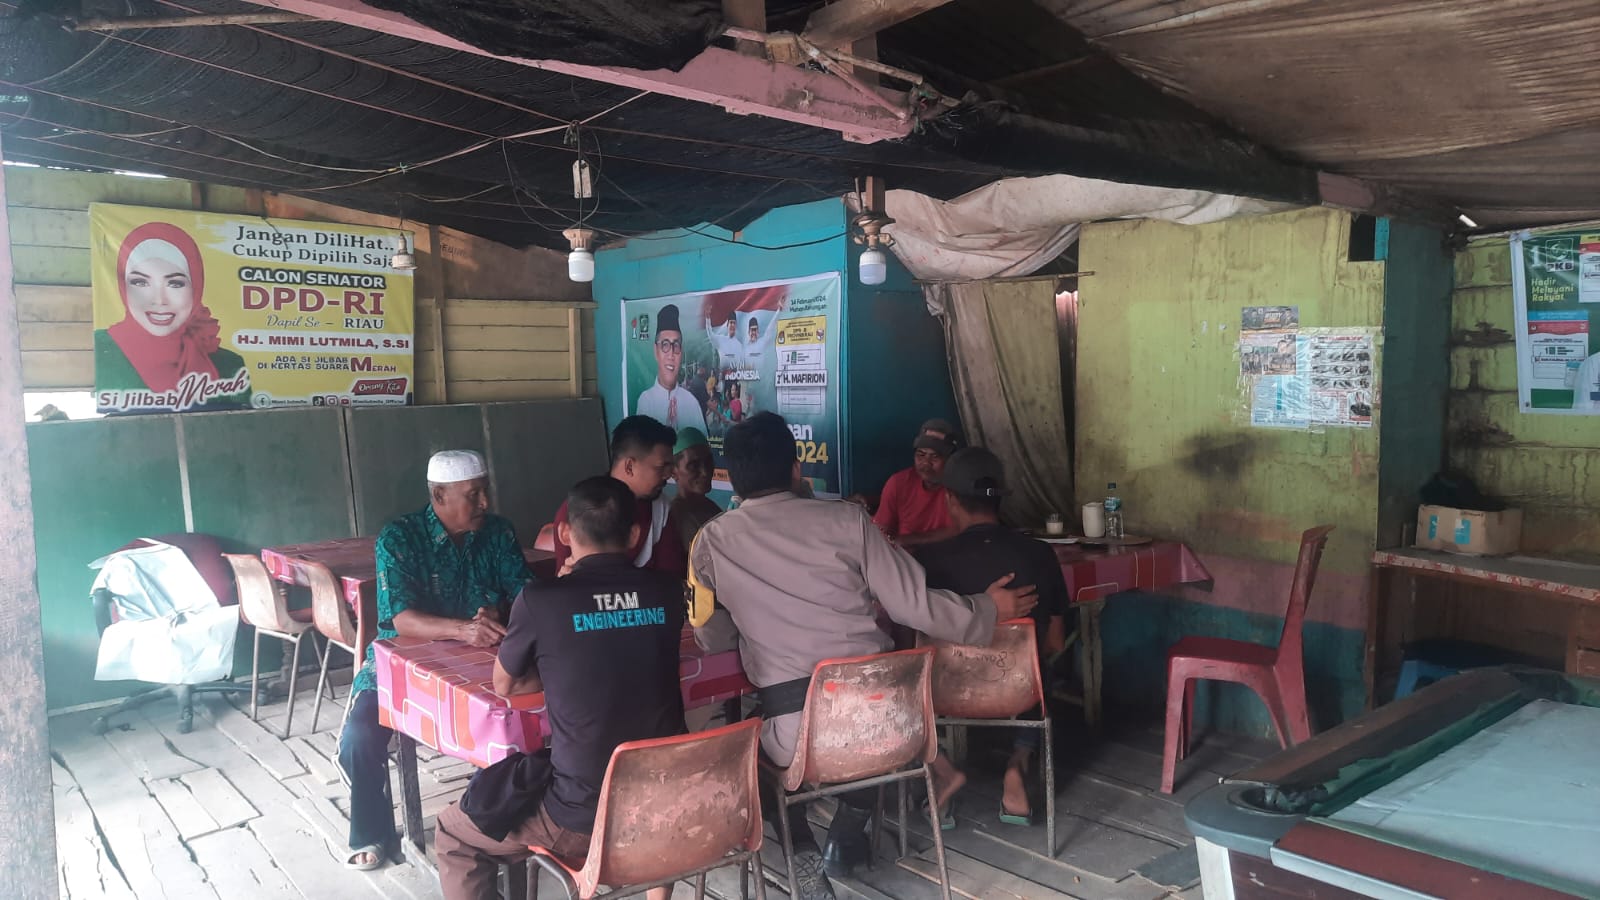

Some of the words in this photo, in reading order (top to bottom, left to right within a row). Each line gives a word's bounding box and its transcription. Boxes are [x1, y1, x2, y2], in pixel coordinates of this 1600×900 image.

[236, 226, 308, 245] Jangan
[233, 244, 293, 262] Cukup
[299, 249, 358, 265] Dipilih
[1531, 245, 1541, 267] 1
[1546, 261, 1573, 271] PKB
[240, 268, 301, 284] CALON
[306, 272, 386, 289] SENATOR
[1531, 277, 1556, 286] Hadir
[1531, 283, 1574, 295] Melayani
[242, 285, 385, 315] DPD-RI
[1532, 294, 1565, 303] Rakyat
[267, 314, 302, 329] Dapil
[345, 317, 385, 330] RIAU
[238, 334, 263, 345] HJ.
[269, 335, 305, 346] MIMI
[310, 336, 378, 349] LUTMILA,
[383, 339, 409, 349] S.SI
[257, 362, 267, 370] DI
[271, 362, 311, 371] KERTAS
[316, 363, 350, 371] SUARA
[275, 355, 297, 364] ADA
[301, 355, 310, 364] SI
[314, 356, 348, 365] JILBAB
[725, 369, 760, 380] INDONESIA
[791, 373, 825, 384] MAFIRION
[100, 392, 118, 406] Si
[122, 392, 178, 409] Jilbab
[176, 369, 247, 409] Merah
[593, 591, 640, 611] TEAM
[572, 606, 665, 633] ENGINEERING
